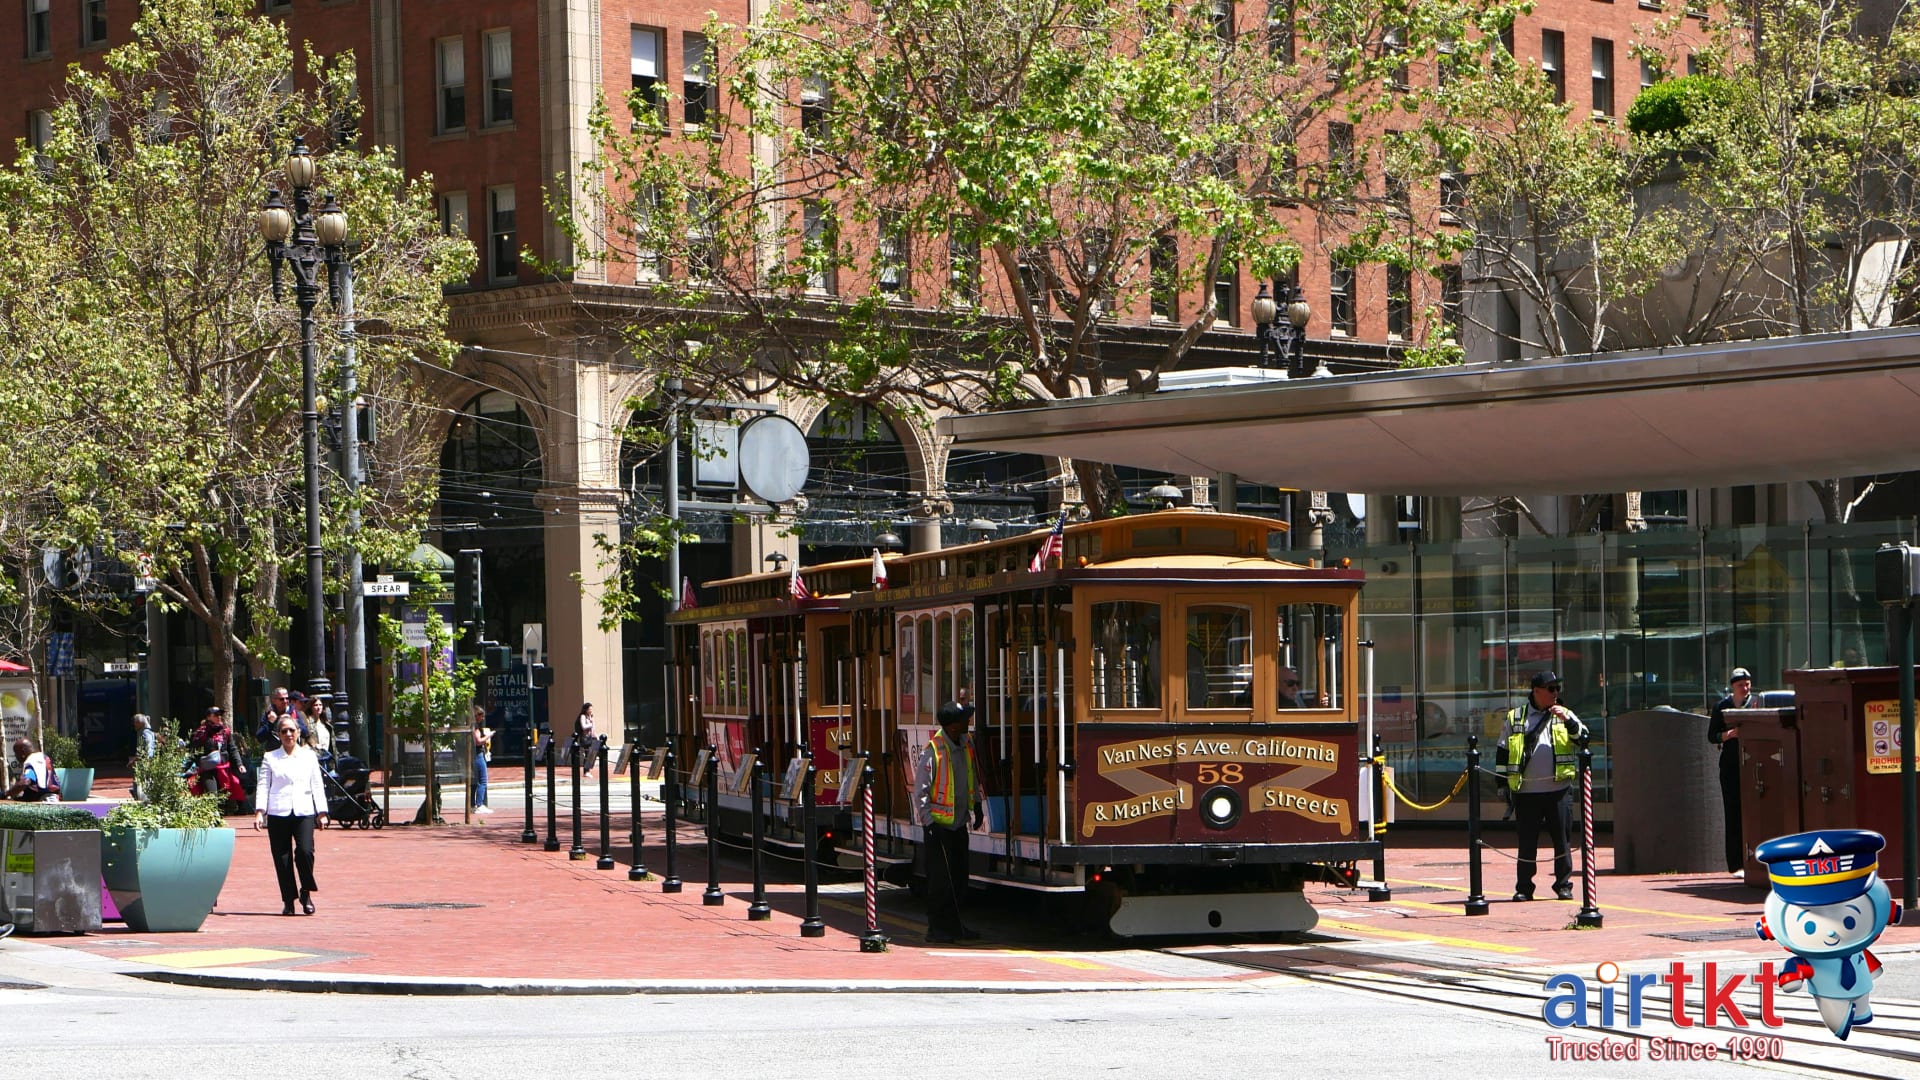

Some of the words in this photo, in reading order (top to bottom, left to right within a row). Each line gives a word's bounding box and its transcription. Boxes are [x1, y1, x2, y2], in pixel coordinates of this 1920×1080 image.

[371, 585, 401, 593] SPEAR
[487, 674, 527, 686] RETAIL
[487, 688, 503, 697] FOR
[1868, 704, 1885, 713] NO
[1103, 743, 1137, 765] Van
[1139, 740, 1187, 759] Ness
[1245, 740, 1335, 763] California
[824, 771, 834, 784] &
[1197, 763, 1245, 785] 58
[1095, 804, 1109, 822] &
[1113, 787, 1184, 820] Market
[1264, 789, 1339, 817] Streets
